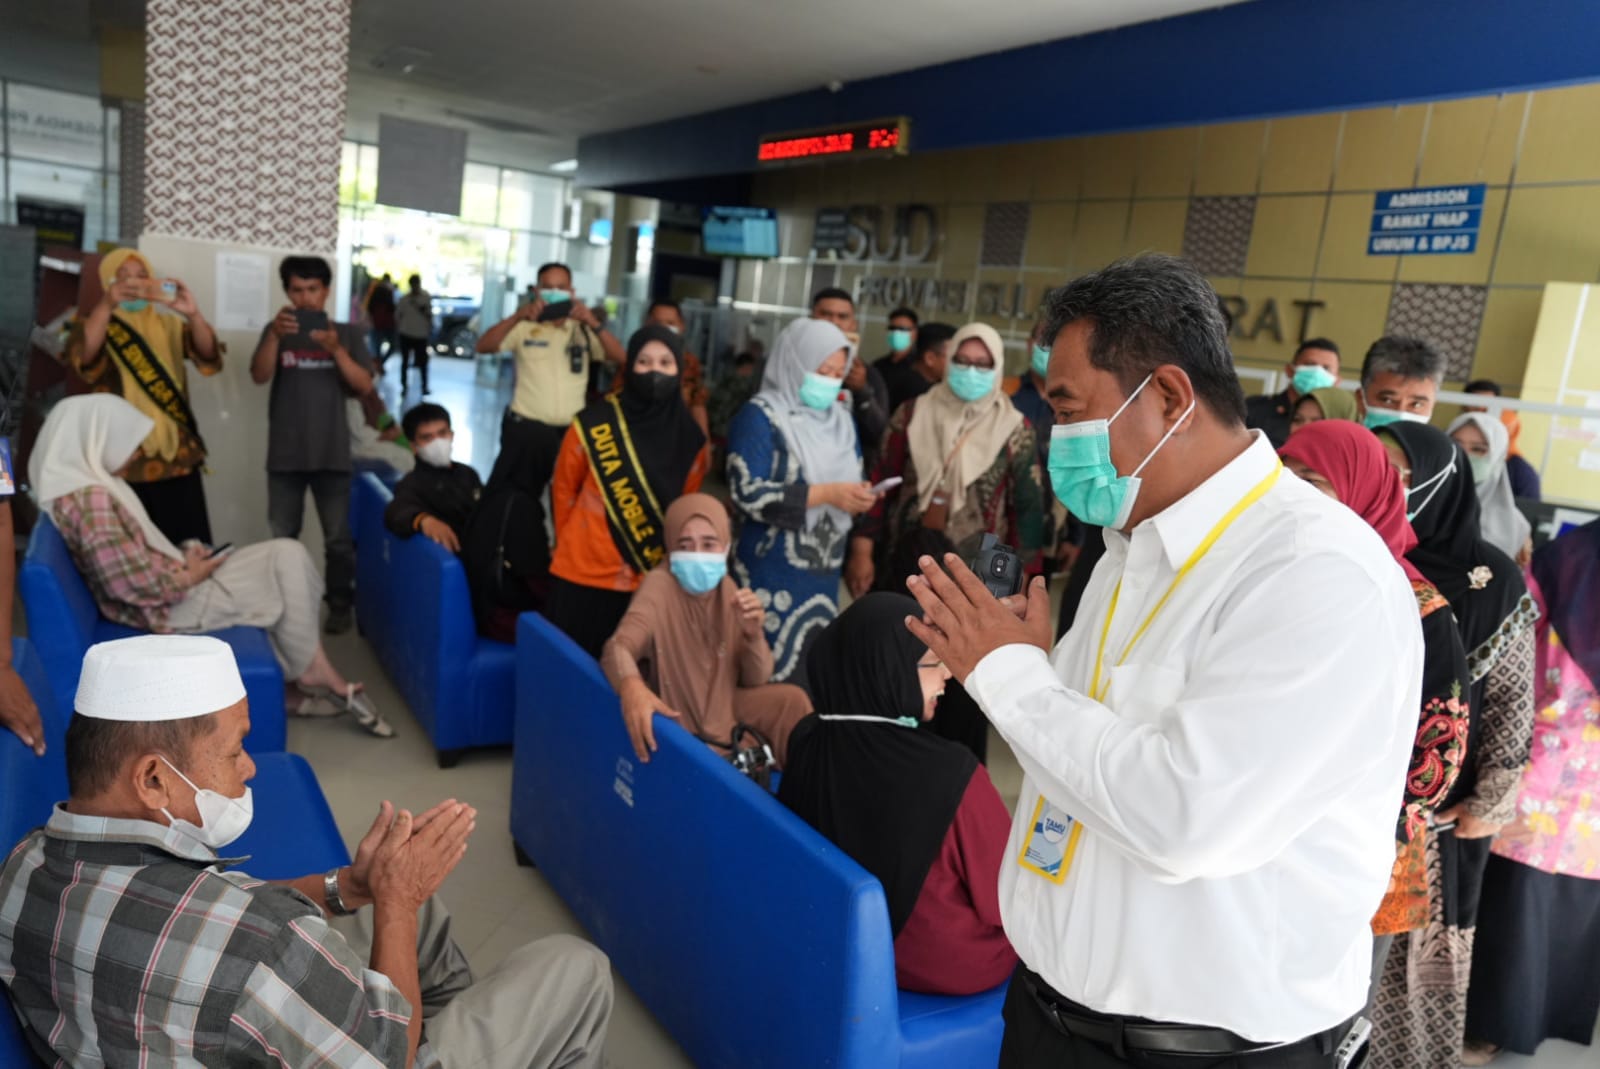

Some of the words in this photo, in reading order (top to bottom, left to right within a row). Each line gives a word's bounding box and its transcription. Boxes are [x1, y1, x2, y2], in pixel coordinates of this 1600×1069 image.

[1389, 188, 1469, 208] ADMISSION
[1381, 212, 1431, 230] RAWAT
[1432, 210, 1469, 228] INAP
[808, 204, 937, 262] SUD
[1372, 236, 1415, 252] UMUM
[1416, 236, 1429, 251] &
[1431, 235, 1470, 251] BPJS
[853, 274, 975, 314] PROVINSI
[1217, 294, 1326, 346] RAT
[590, 422, 623, 475] DUTA
[610, 477, 655, 542] MOBILE
[1046, 818, 1066, 832] TAMU
